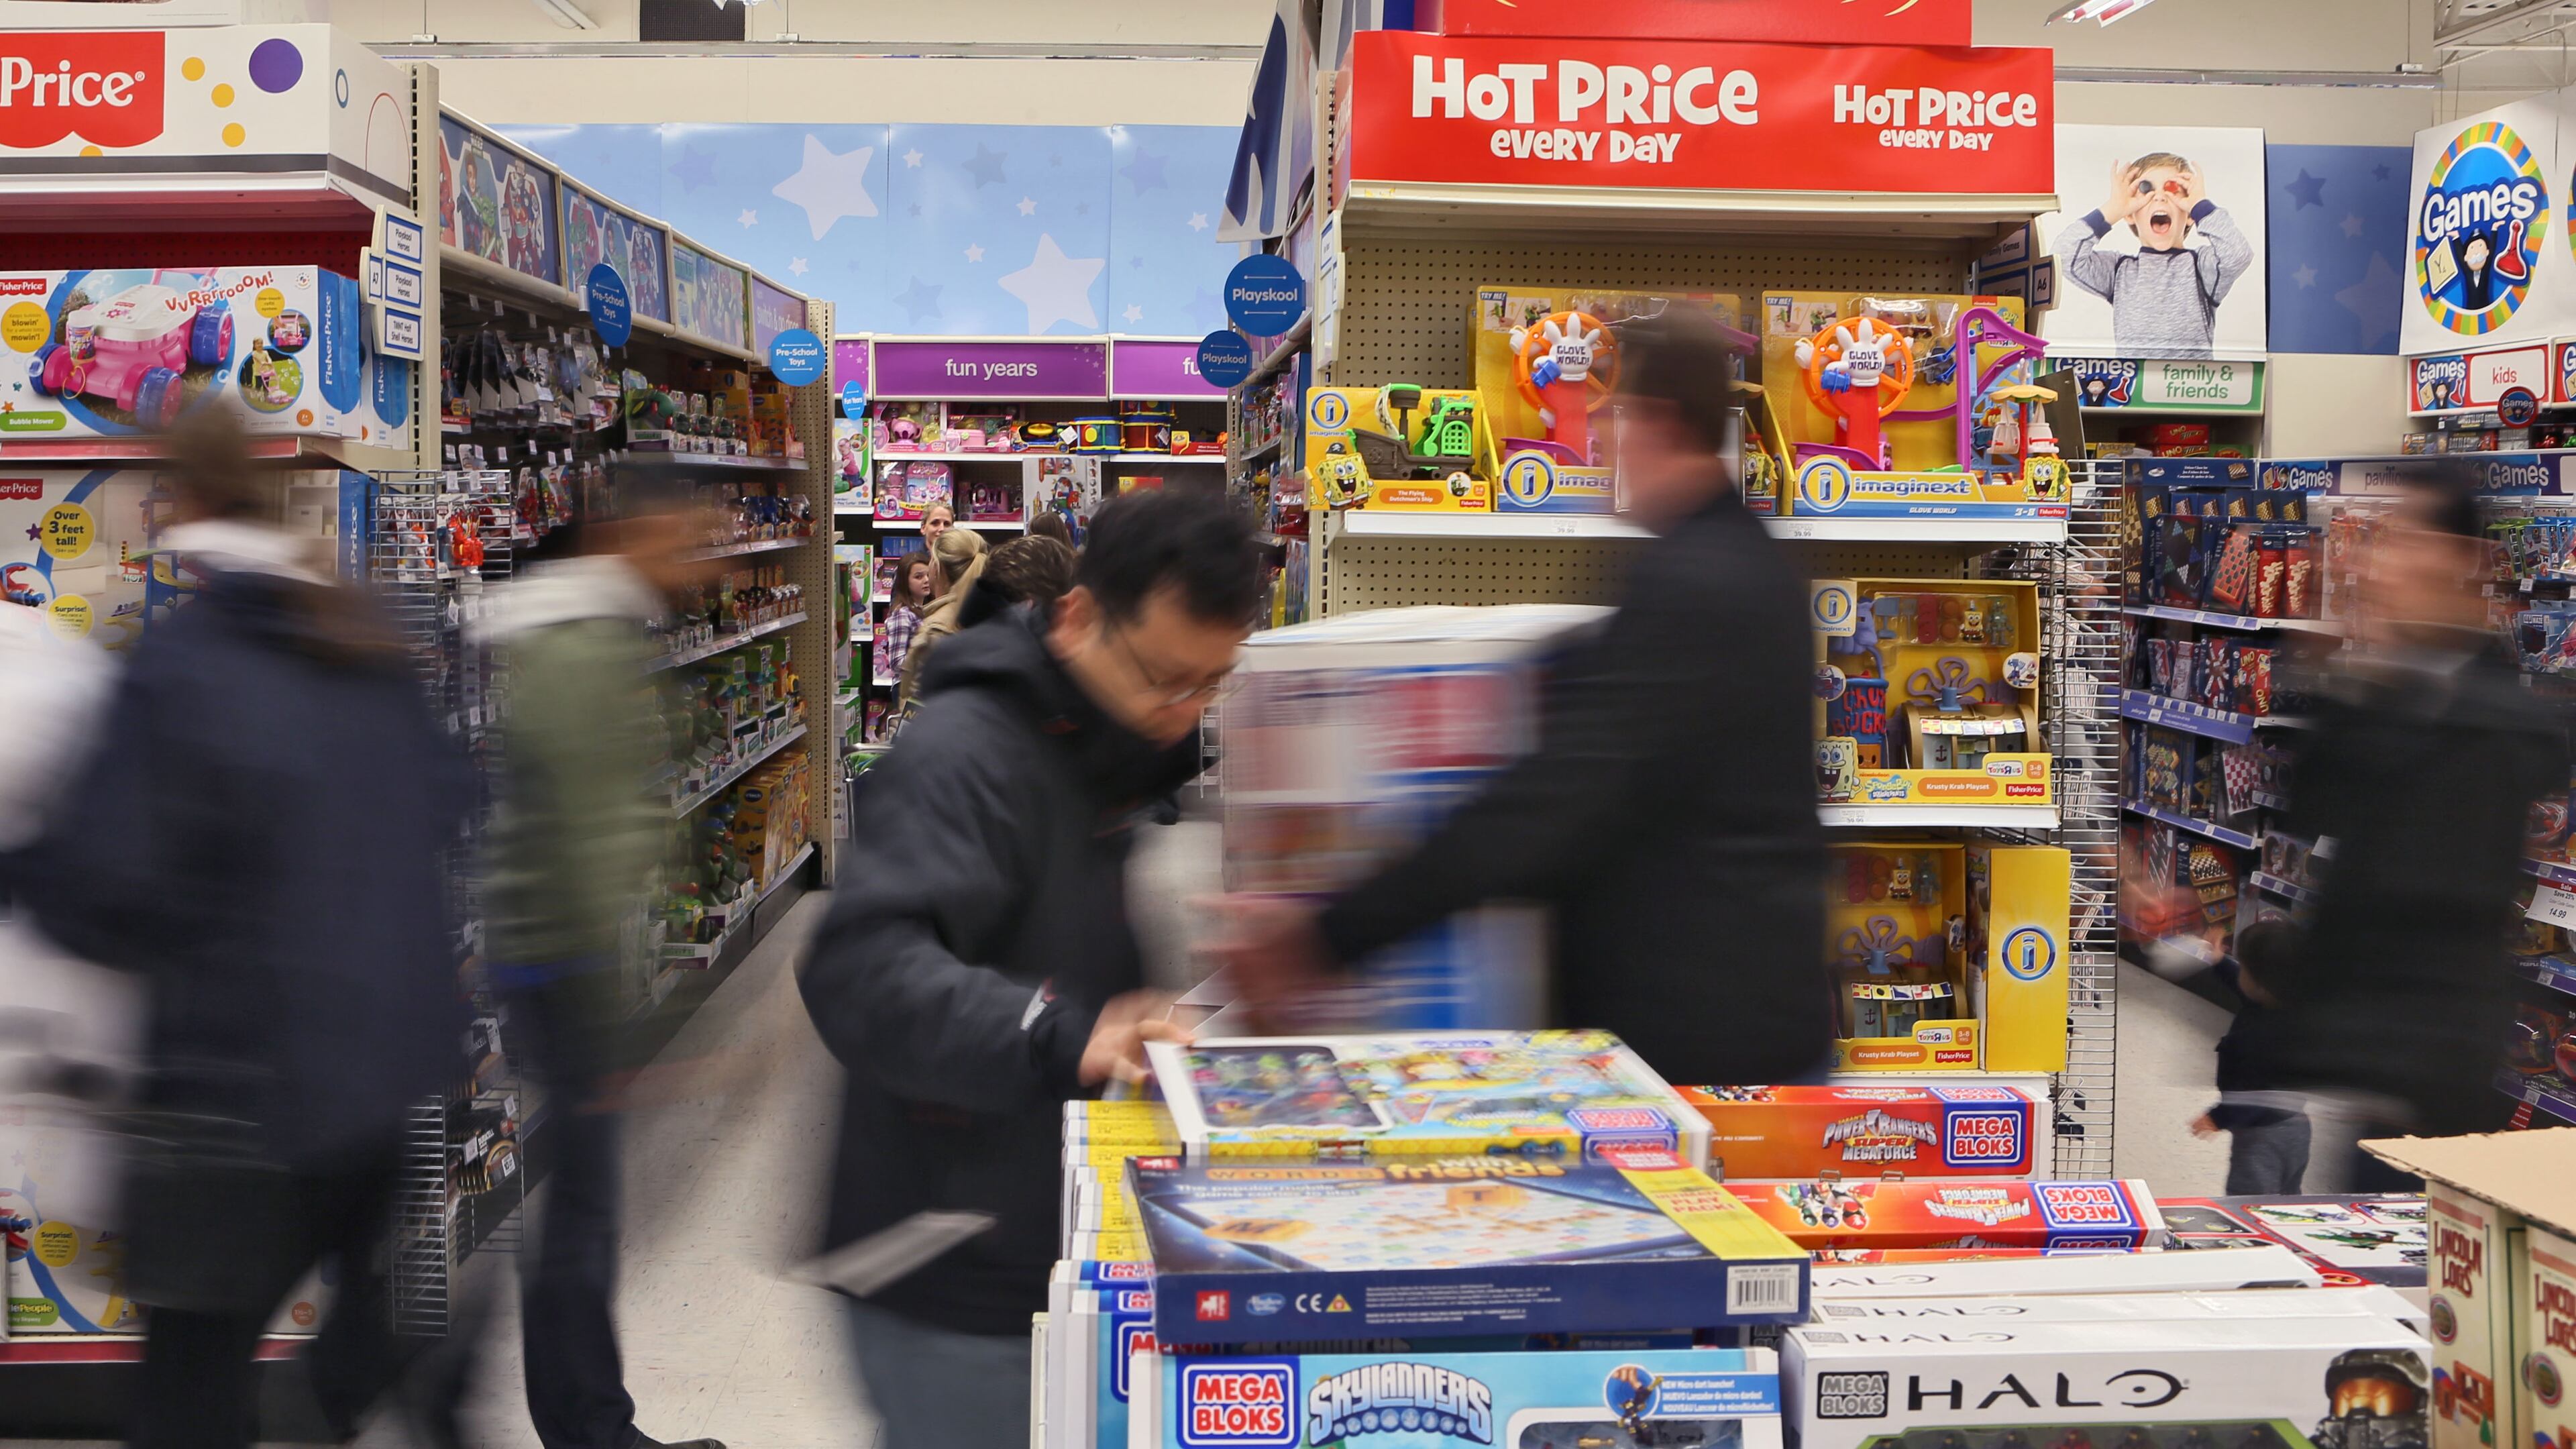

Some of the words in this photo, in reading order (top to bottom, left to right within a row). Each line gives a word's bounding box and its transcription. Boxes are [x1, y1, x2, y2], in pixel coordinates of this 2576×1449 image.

[2424, 183, 2538, 242] Games
[395, 229, 412, 241] Playskool
[397, 242, 410, 252] Heroes
[2002, 241, 2019, 252] Games
[396, 275, 412, 287] Playskool
[2037, 280, 2047, 291] A6
[397, 287, 410, 297] Heroes
[592, 289, 625, 308] Pre-School
[1232, 288, 1298, 305] Playskool
[602, 305, 616, 319] Toys
[401, 334, 413, 344] Heroes
[776, 347, 818, 358] Pre-School
[1556, 345, 1586, 355] GLOVE
[1849, 351, 1878, 360] GLOVE
[788, 358, 806, 366] Toys
[1202, 353, 1247, 365] Playskool
[1556, 356, 1590, 365] WORLD!
[945, 358, 977, 376] fun
[983, 360, 1038, 380] years
[1183, 358, 1199, 376] fu
[1849, 362, 1882, 370] WORLD!
[2417, 361, 2466, 383] Games
[2492, 366, 2518, 384] kids
[2163, 364, 2215, 384] family
[2220, 365, 2233, 382] &
[2166, 384, 2229, 399] friends
[2502, 398, 2534, 408] Games
[2169, 425, 2186, 436] UNO
[2161, 446, 2182, 458] UNO
[2289, 468, 2333, 491] Games
[2485, 464, 2548, 490] Games
[1854, 478, 1970, 496] imaginext
[54, 511, 80, 520] Over
[2014, 508, 2035, 517] 3-8
[49, 521, 59, 533] 3
[62, 525, 85, 534] feet
[56, 536, 76, 545] tall!
[2241, 651, 2255, 667] UNO
[2255, 688, 2269, 713] UNO
[1966, 783, 1990, 791] Playset
[2561, 883, 2572, 892] Sale
[2549, 907, 2567, 919] 14.99
[1822, 1118, 1866, 1148] POWER
[1879, 1112, 1937, 1146] RANGERS
[1955, 1118, 2015, 1136] MEGA
[1853, 1138, 1909, 1146] SUPER
[1954, 1137, 2014, 1157] BLOKS
[1842, 1146, 1917, 1161] MEGAFORCE
[1438, 1155, 1512, 1168] with
[1212, 1168, 1378, 1179] WORDS
[1387, 1161, 1566, 1179] friends
[2045, 1187, 2112, 1203] BLOKS
[2054, 1203, 2121, 1221] MEGA
[2434, 1220, 2482, 1277] LINCOLN
[2442, 1254, 2473, 1298] LOGS
[1872, 1305, 2030, 1318] HALO
[1855, 1332, 2018, 1344] HALO
[1194, 1377, 1284, 1402] MEGA
[1821, 1375, 1885, 1395] MEGA
[1908, 1368, 2190, 1411] HALO
[1309, 1361, 1493, 1446] SKYLANDERS
[1821, 1396, 1884, 1415] BLOKS
[1194, 1407, 1284, 1433] BLOKS
